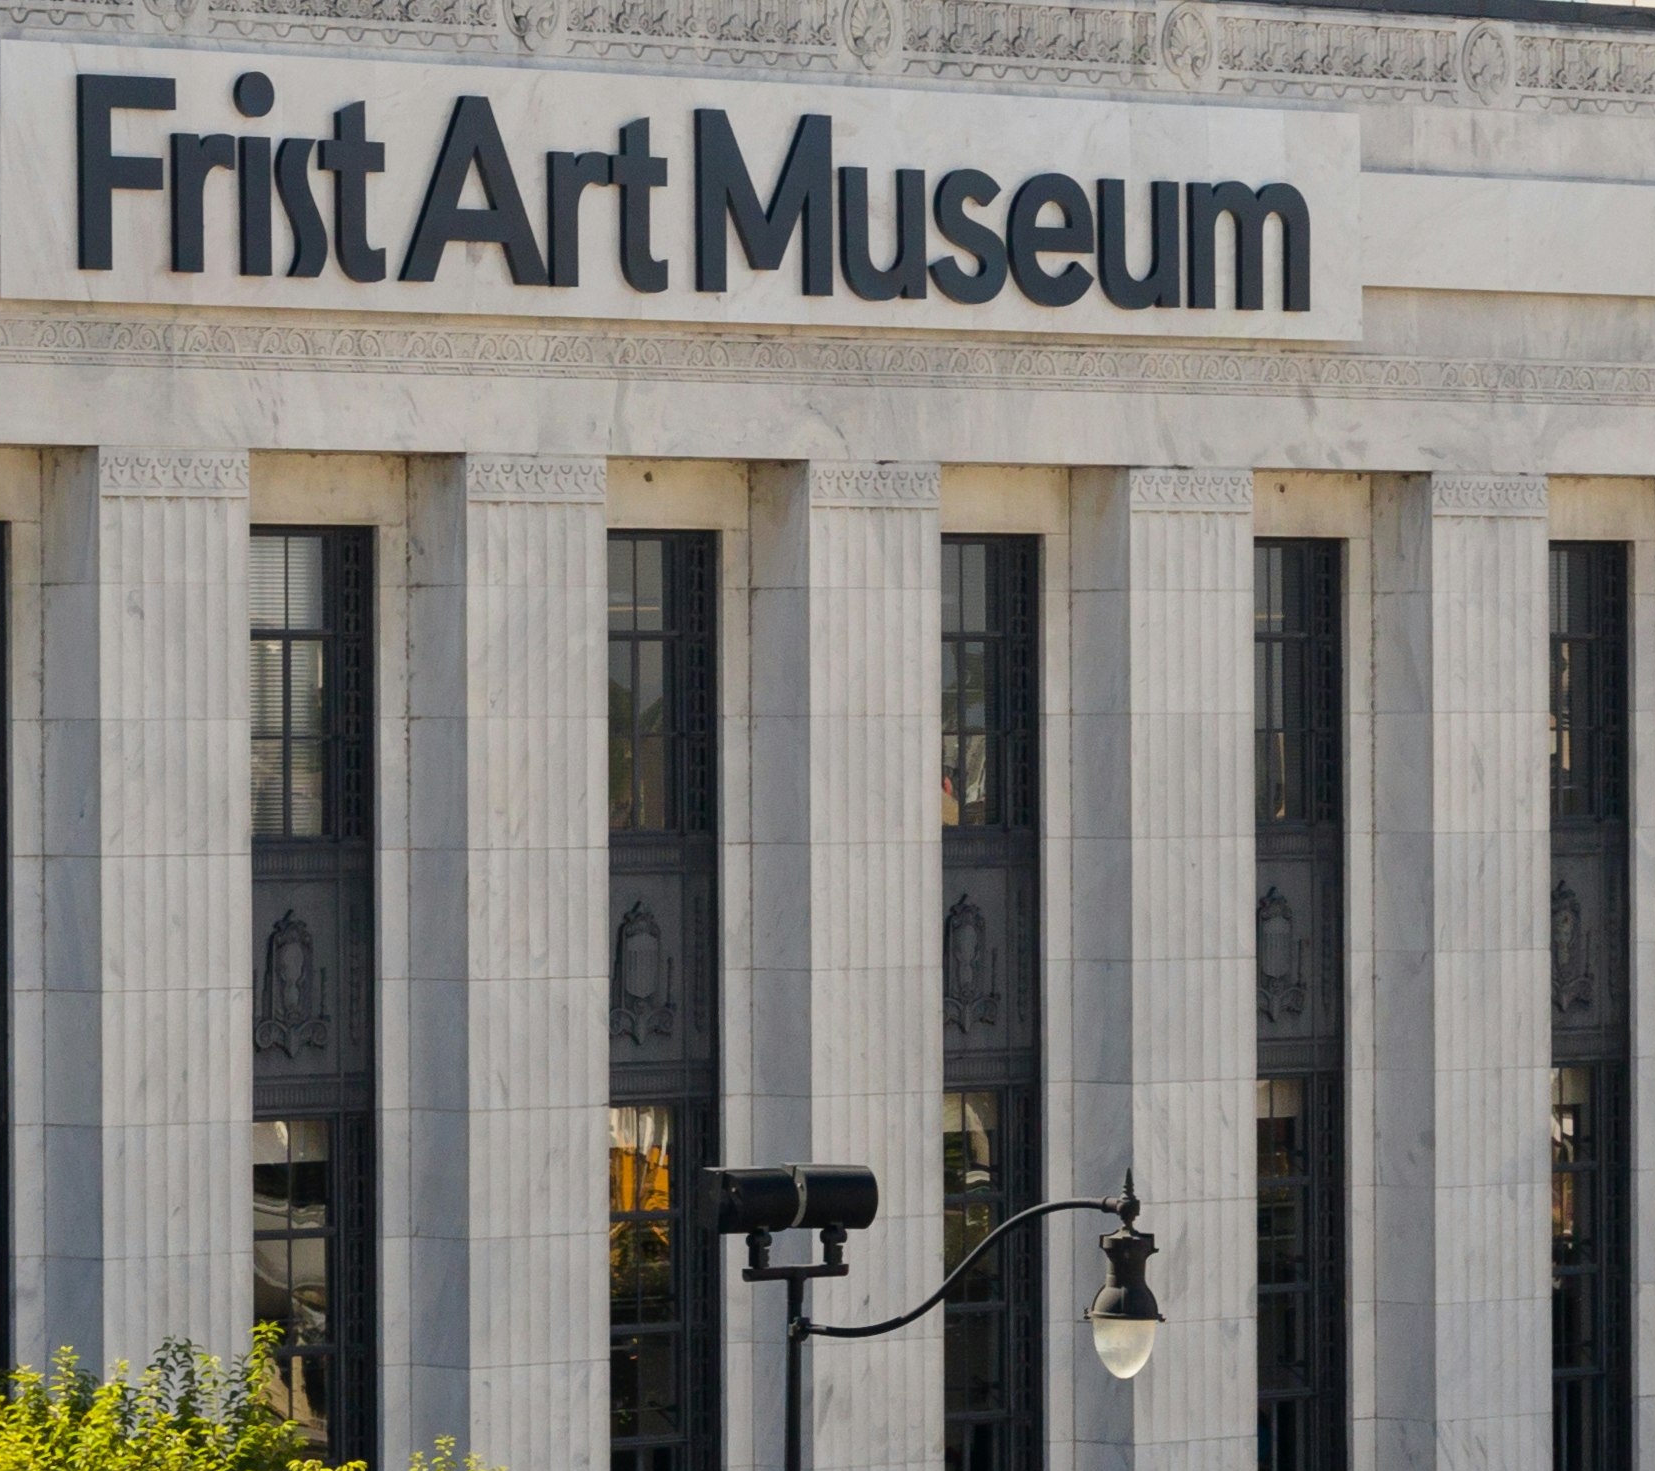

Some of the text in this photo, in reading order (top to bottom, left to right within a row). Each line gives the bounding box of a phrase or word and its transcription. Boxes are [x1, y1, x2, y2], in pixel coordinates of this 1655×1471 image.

[75, 71, 1312, 313] Frist Art Museum
